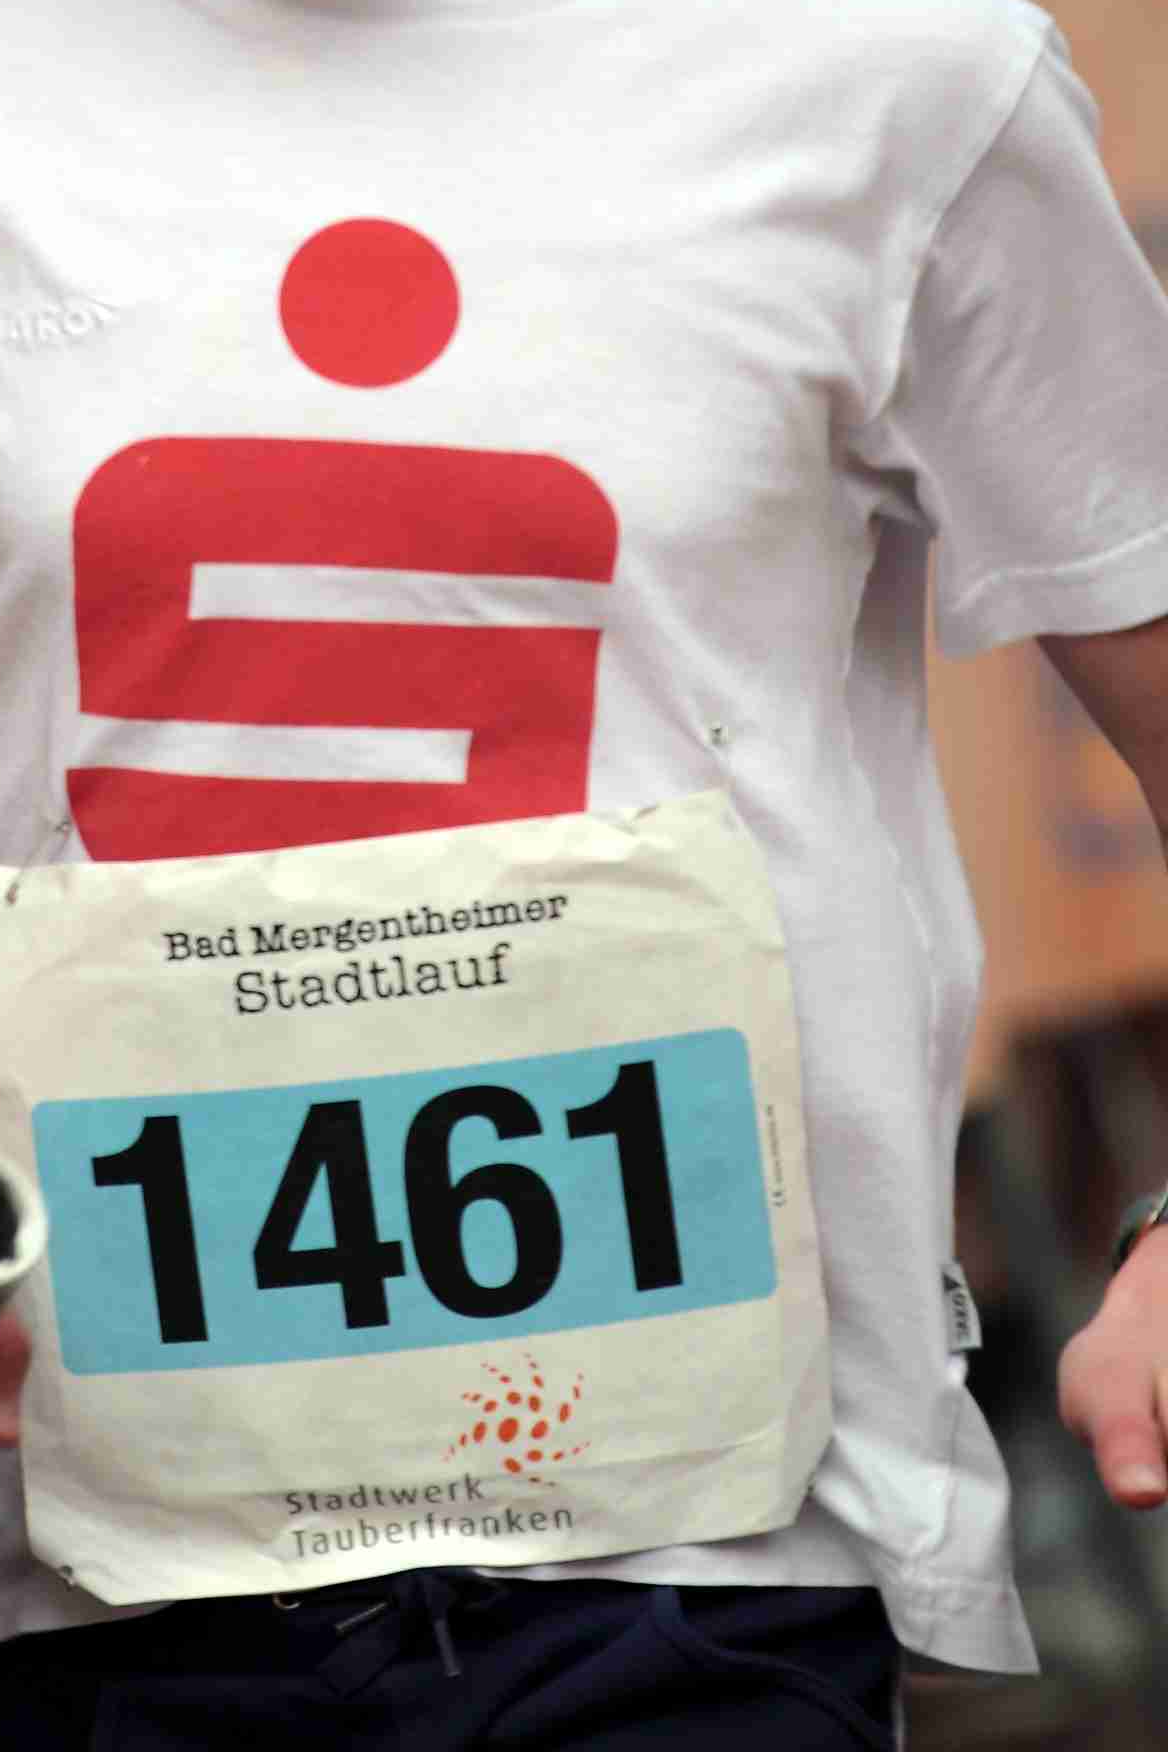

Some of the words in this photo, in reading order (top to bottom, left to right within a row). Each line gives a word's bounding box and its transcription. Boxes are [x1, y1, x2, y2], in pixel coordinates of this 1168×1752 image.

[163, 927, 241, 962] Bad
[249, 894, 569, 953] Mergentheimer
[234, 941, 512, 1015] Stadtlauf
[90, 1058, 685, 1346] 1461
[284, 1473, 485, 1515] Stadtwerk
[291, 1506, 574, 1558] Tauberfranken
